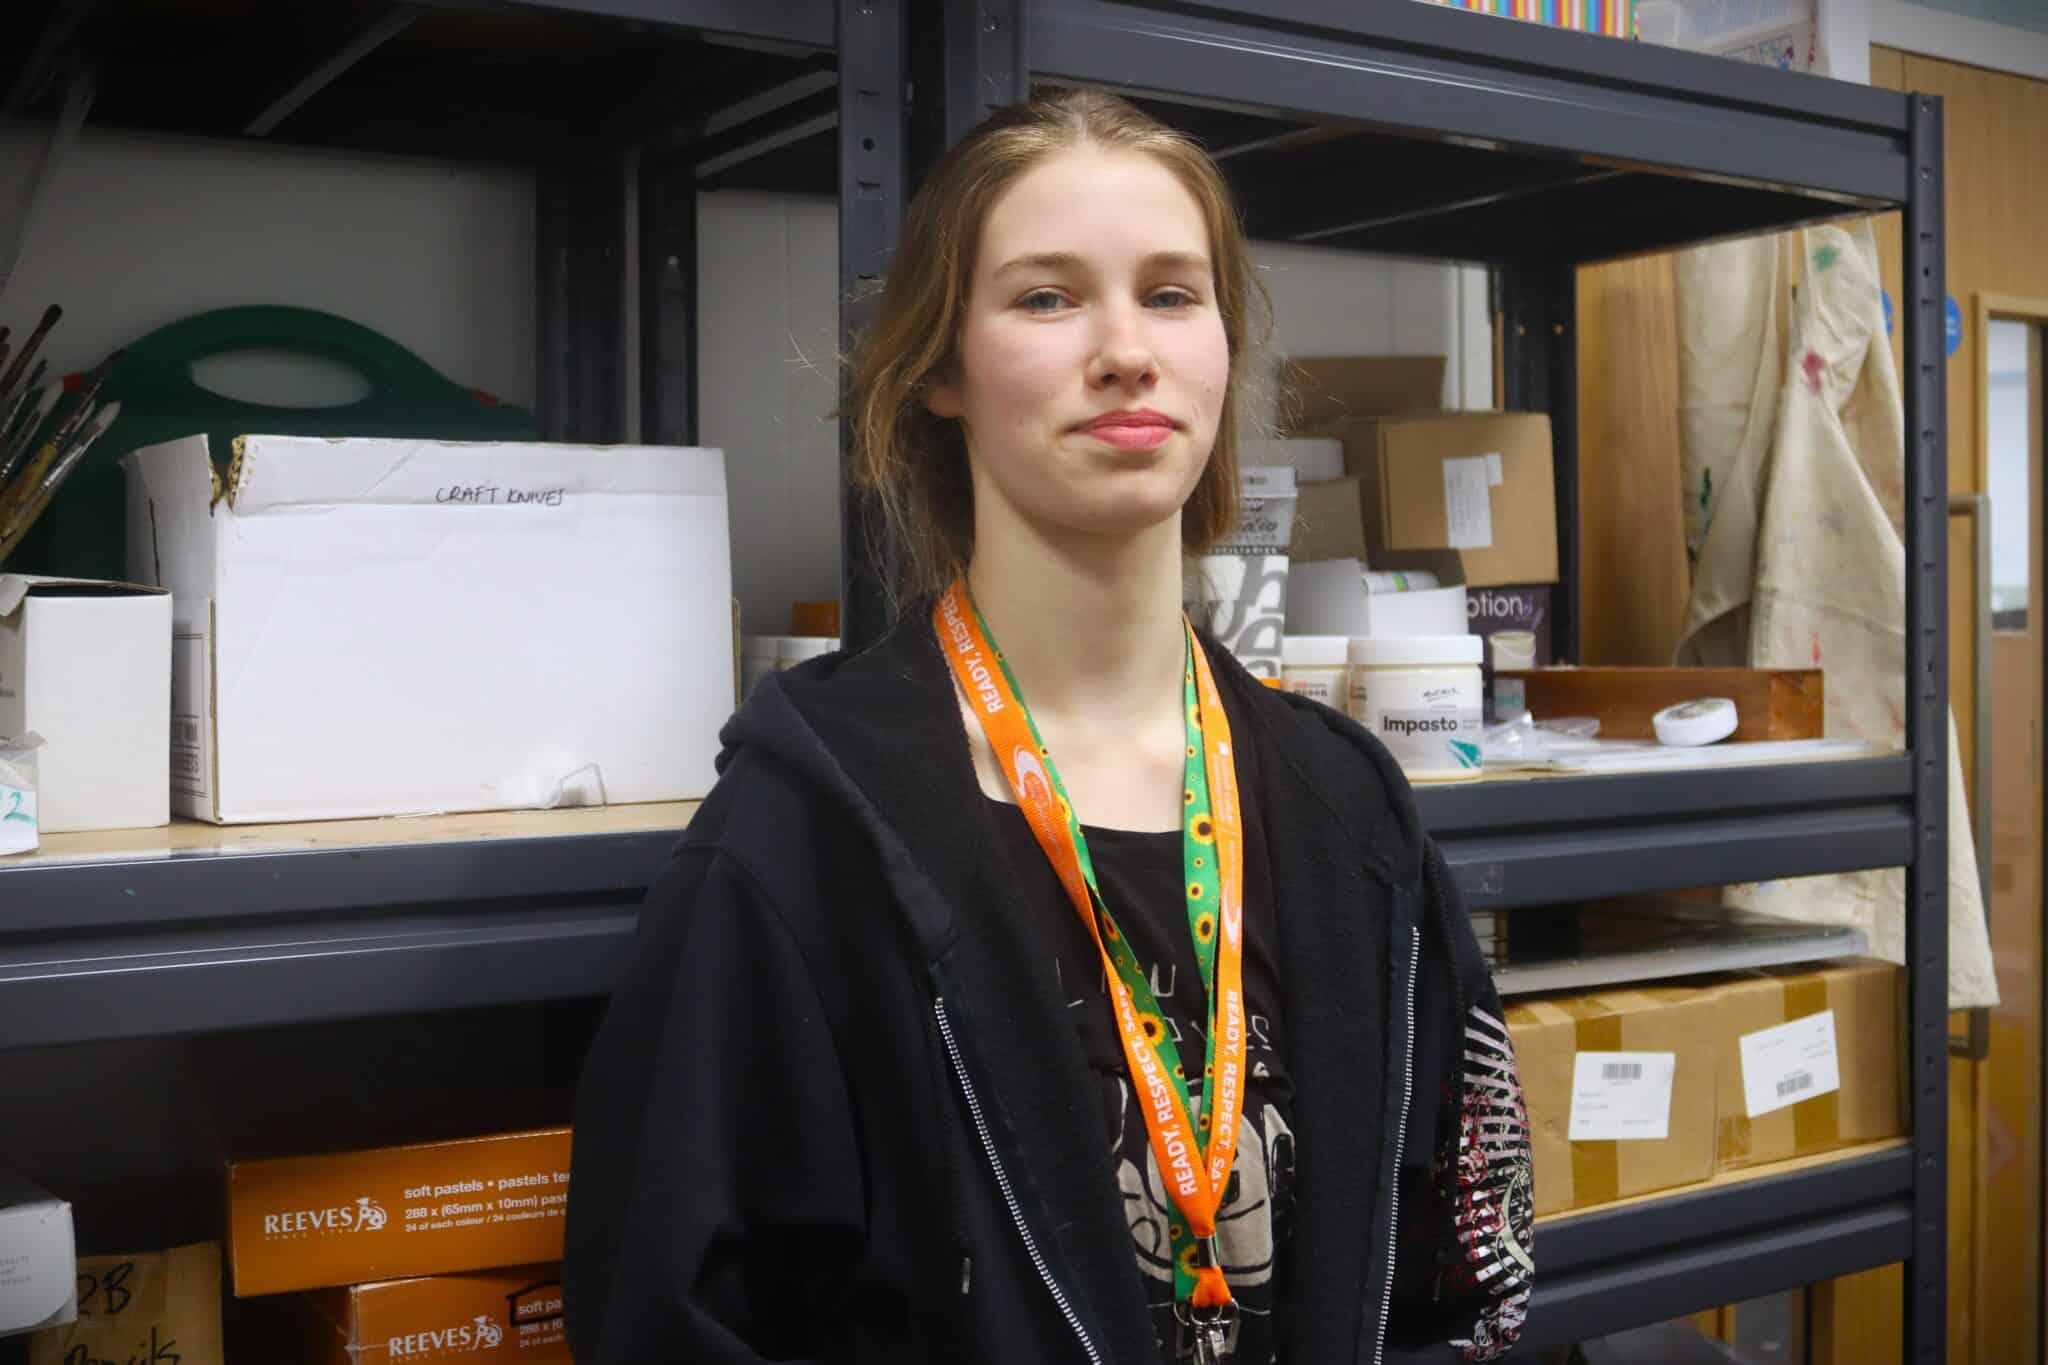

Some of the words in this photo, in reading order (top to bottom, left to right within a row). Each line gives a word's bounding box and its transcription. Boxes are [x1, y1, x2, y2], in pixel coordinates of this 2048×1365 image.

[436, 485, 499, 504] CRAFT
[506, 487, 565, 506] KNIVES
[965, 651, 1005, 714] READY,
[1384, 715, 1458, 736] Impasto
[1222, 988, 1241, 1057] READY,
[1161, 1123, 1199, 1197] READY,
[404, 1184, 431, 1199] soft
[434, 1179, 484, 1197] pastels
[498, 1173, 549, 1190] pastels
[264, 1206, 353, 1234] REEVES
[405, 1207, 428, 1219] 288
[441, 1202, 483, 1217] (65mm
[498, 1195, 538, 1210] 10mm)
[77, 1262, 134, 1316] 2B
[519, 1301, 543, 1315] soft
[388, 1326, 472, 1356] REEVES
